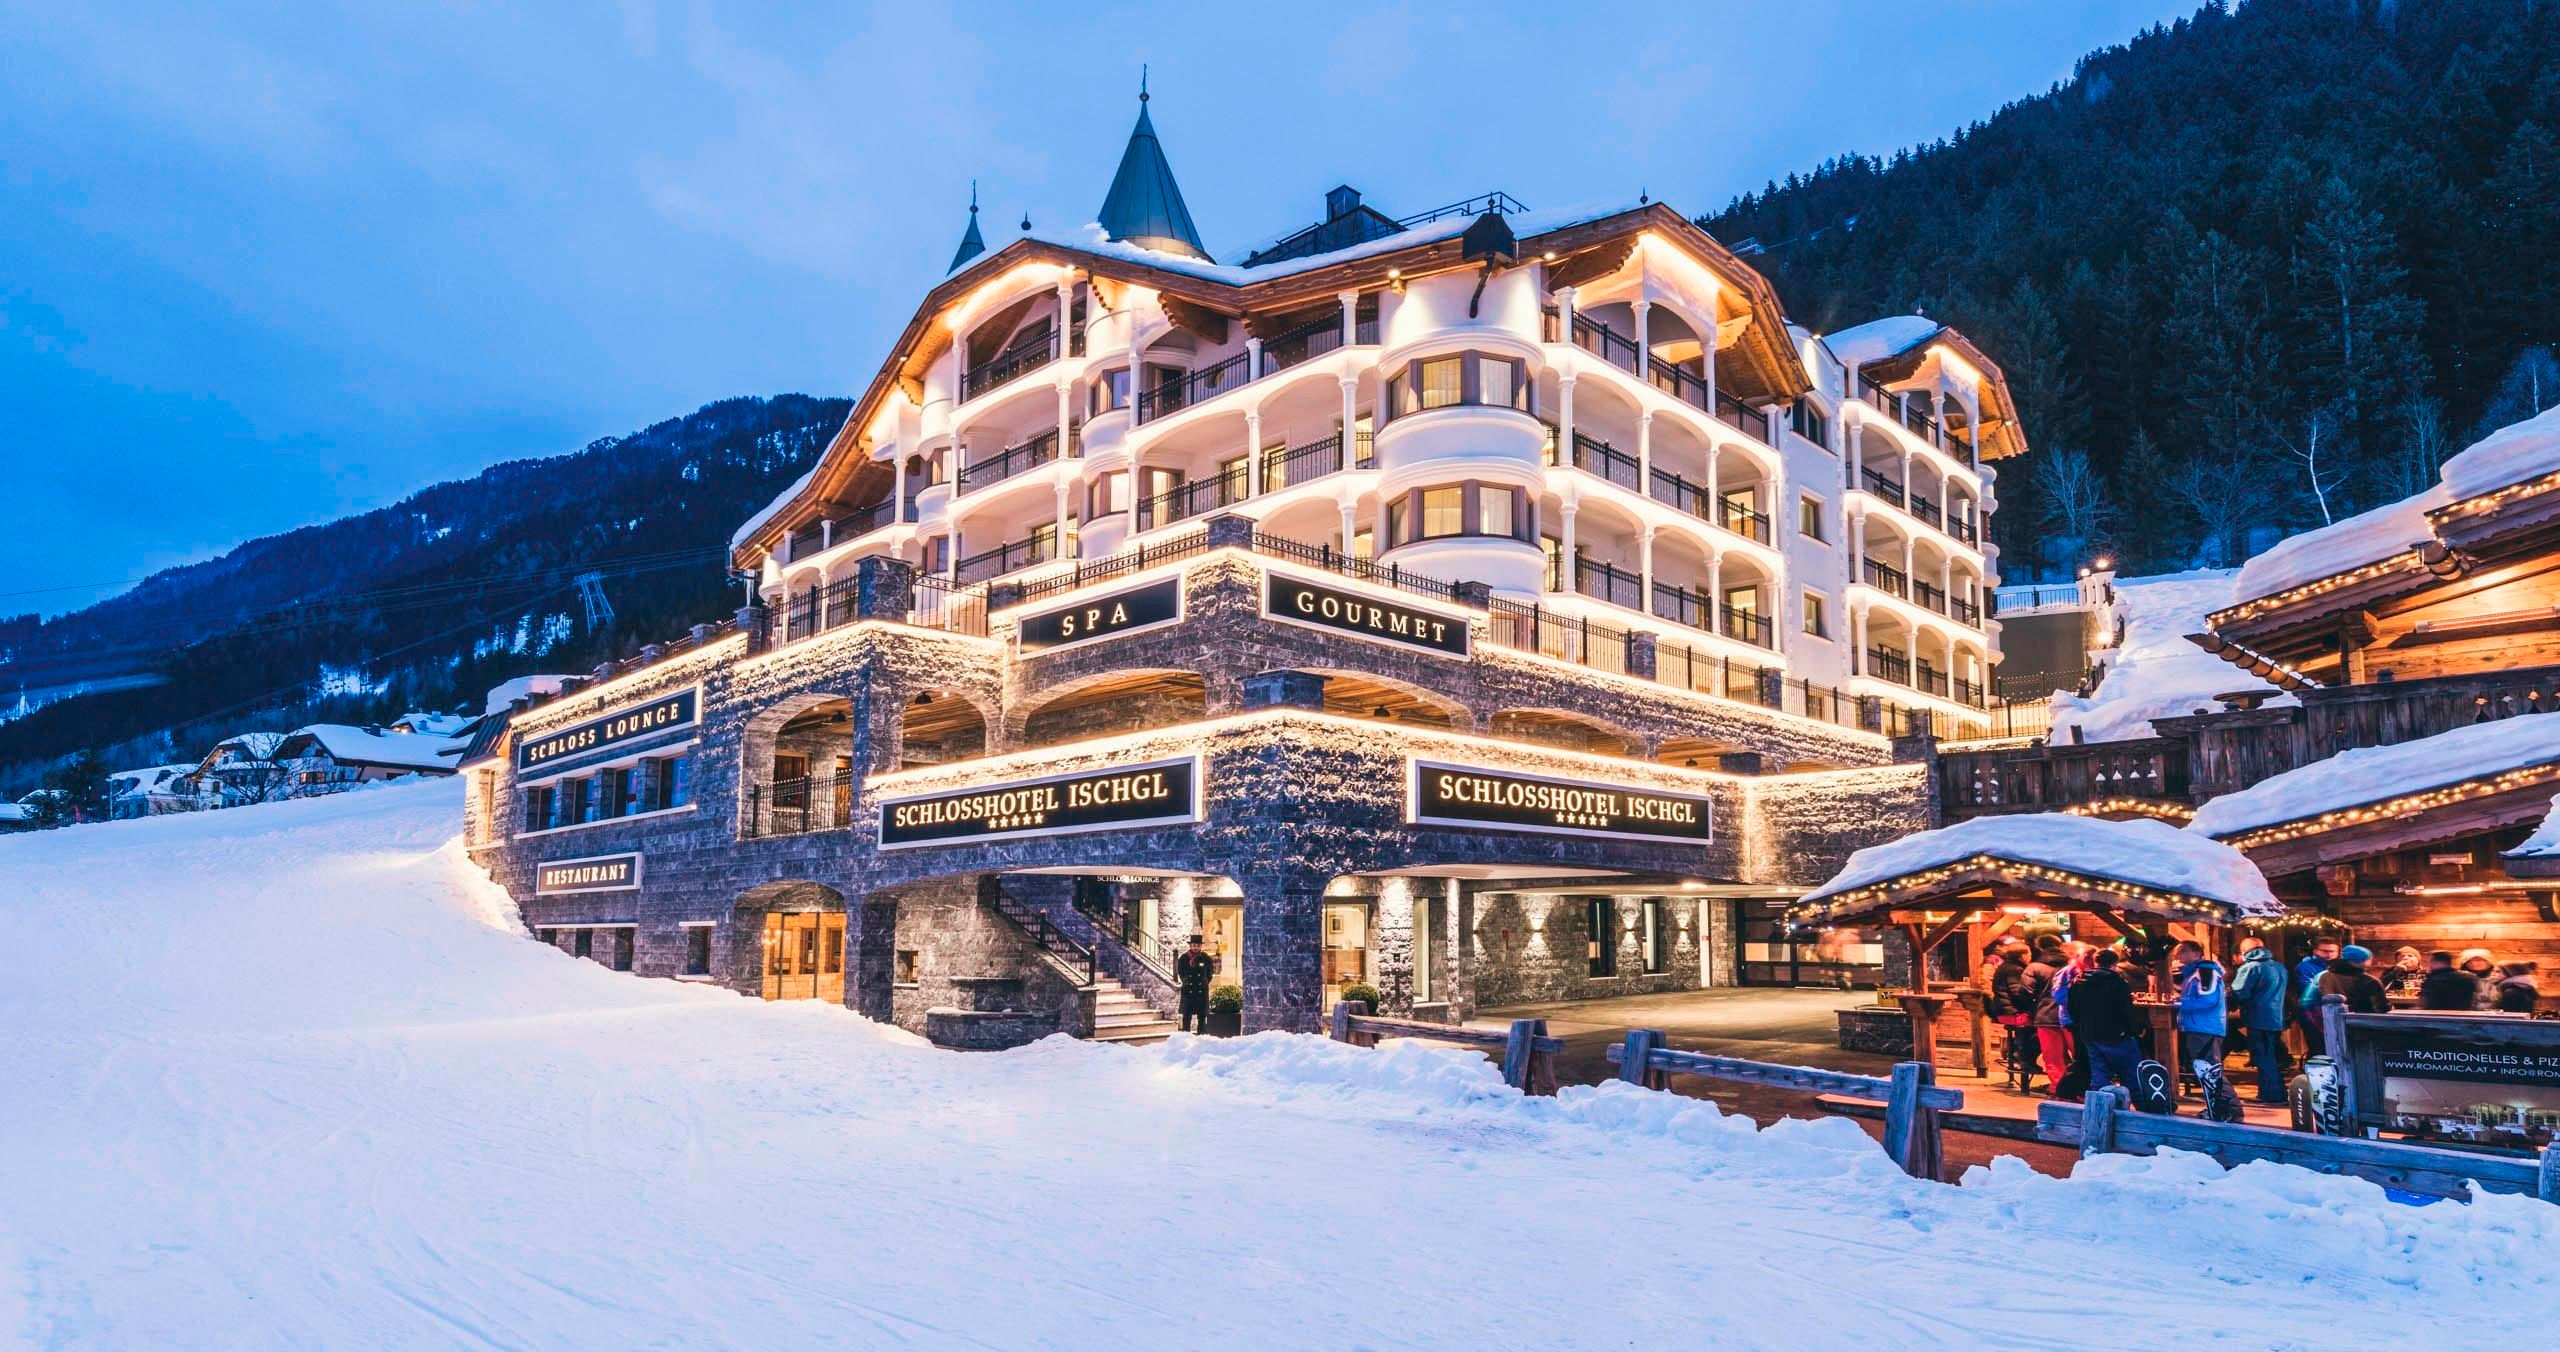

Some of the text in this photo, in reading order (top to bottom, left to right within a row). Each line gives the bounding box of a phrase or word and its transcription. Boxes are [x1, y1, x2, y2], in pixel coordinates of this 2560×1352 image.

[1061, 602, 1129, 637] SPA
[1297, 590, 1447, 643] GOURMET
[529, 703, 680, 762] SCHLOSS LOUNGE
[895, 772, 1169, 828] SCHLOSSHOTEL ISCHGL
[1439, 774, 1697, 824] SCHLOSSHOTEL ISCHGL
[545, 863, 628, 886] RESTAURANT
[2384, 1060, 2489, 1074] WWW.ROMATICA.AT
[2407, 1050, 2560, 1068] TRADITIONELLES & PIZ
